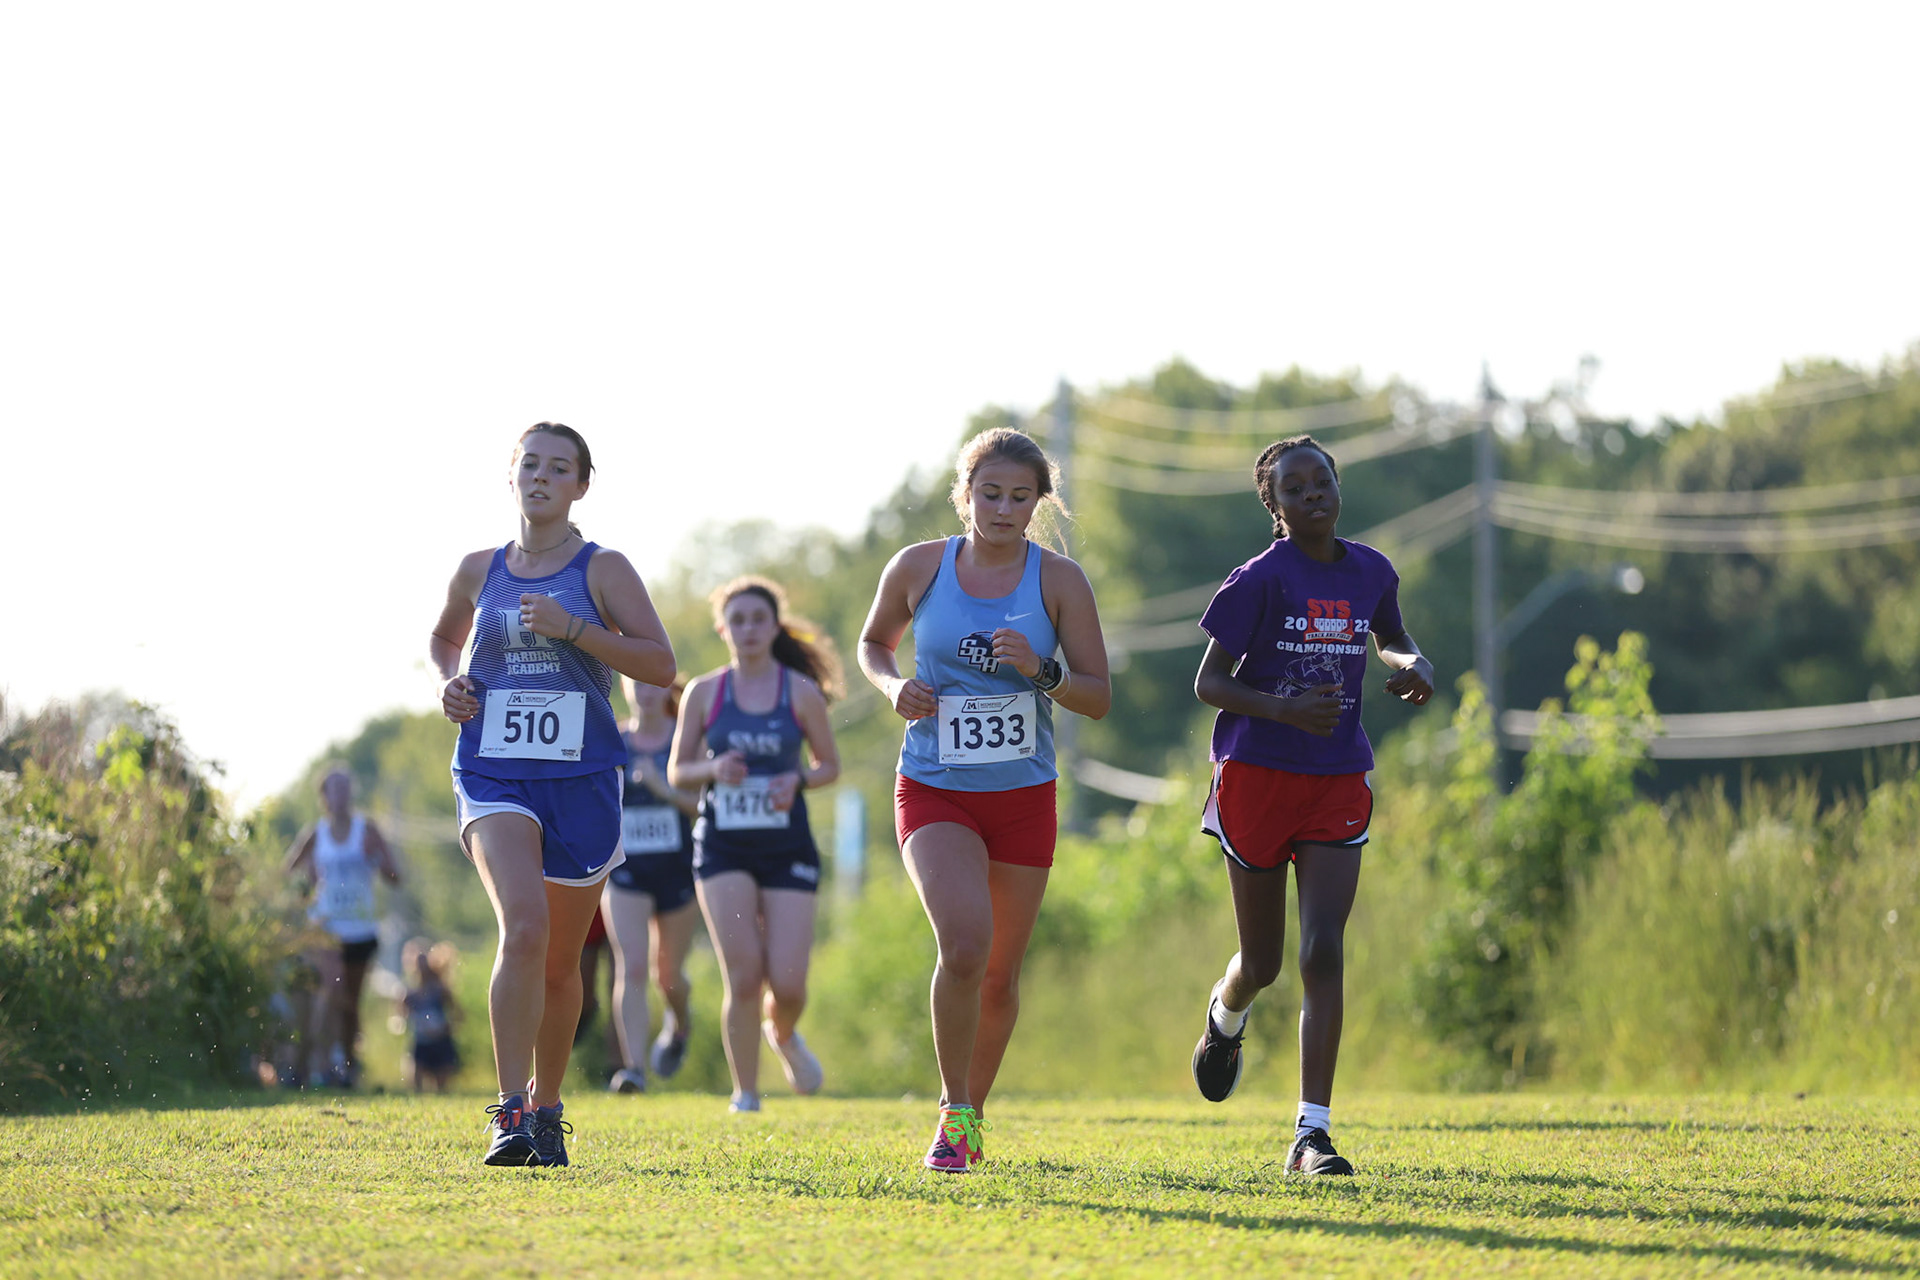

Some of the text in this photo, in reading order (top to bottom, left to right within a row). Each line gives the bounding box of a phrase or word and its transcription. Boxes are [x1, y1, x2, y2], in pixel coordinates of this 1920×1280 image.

[1307, 598, 1351, 619] SYS
[1284, 616, 1369, 633] 20 22
[504, 650, 559, 664] HARDING
[960, 639, 998, 673] SBA
[507, 662, 561, 675] ACADEMY
[503, 711, 560, 745] 510
[950, 714, 1025, 750] 1333
